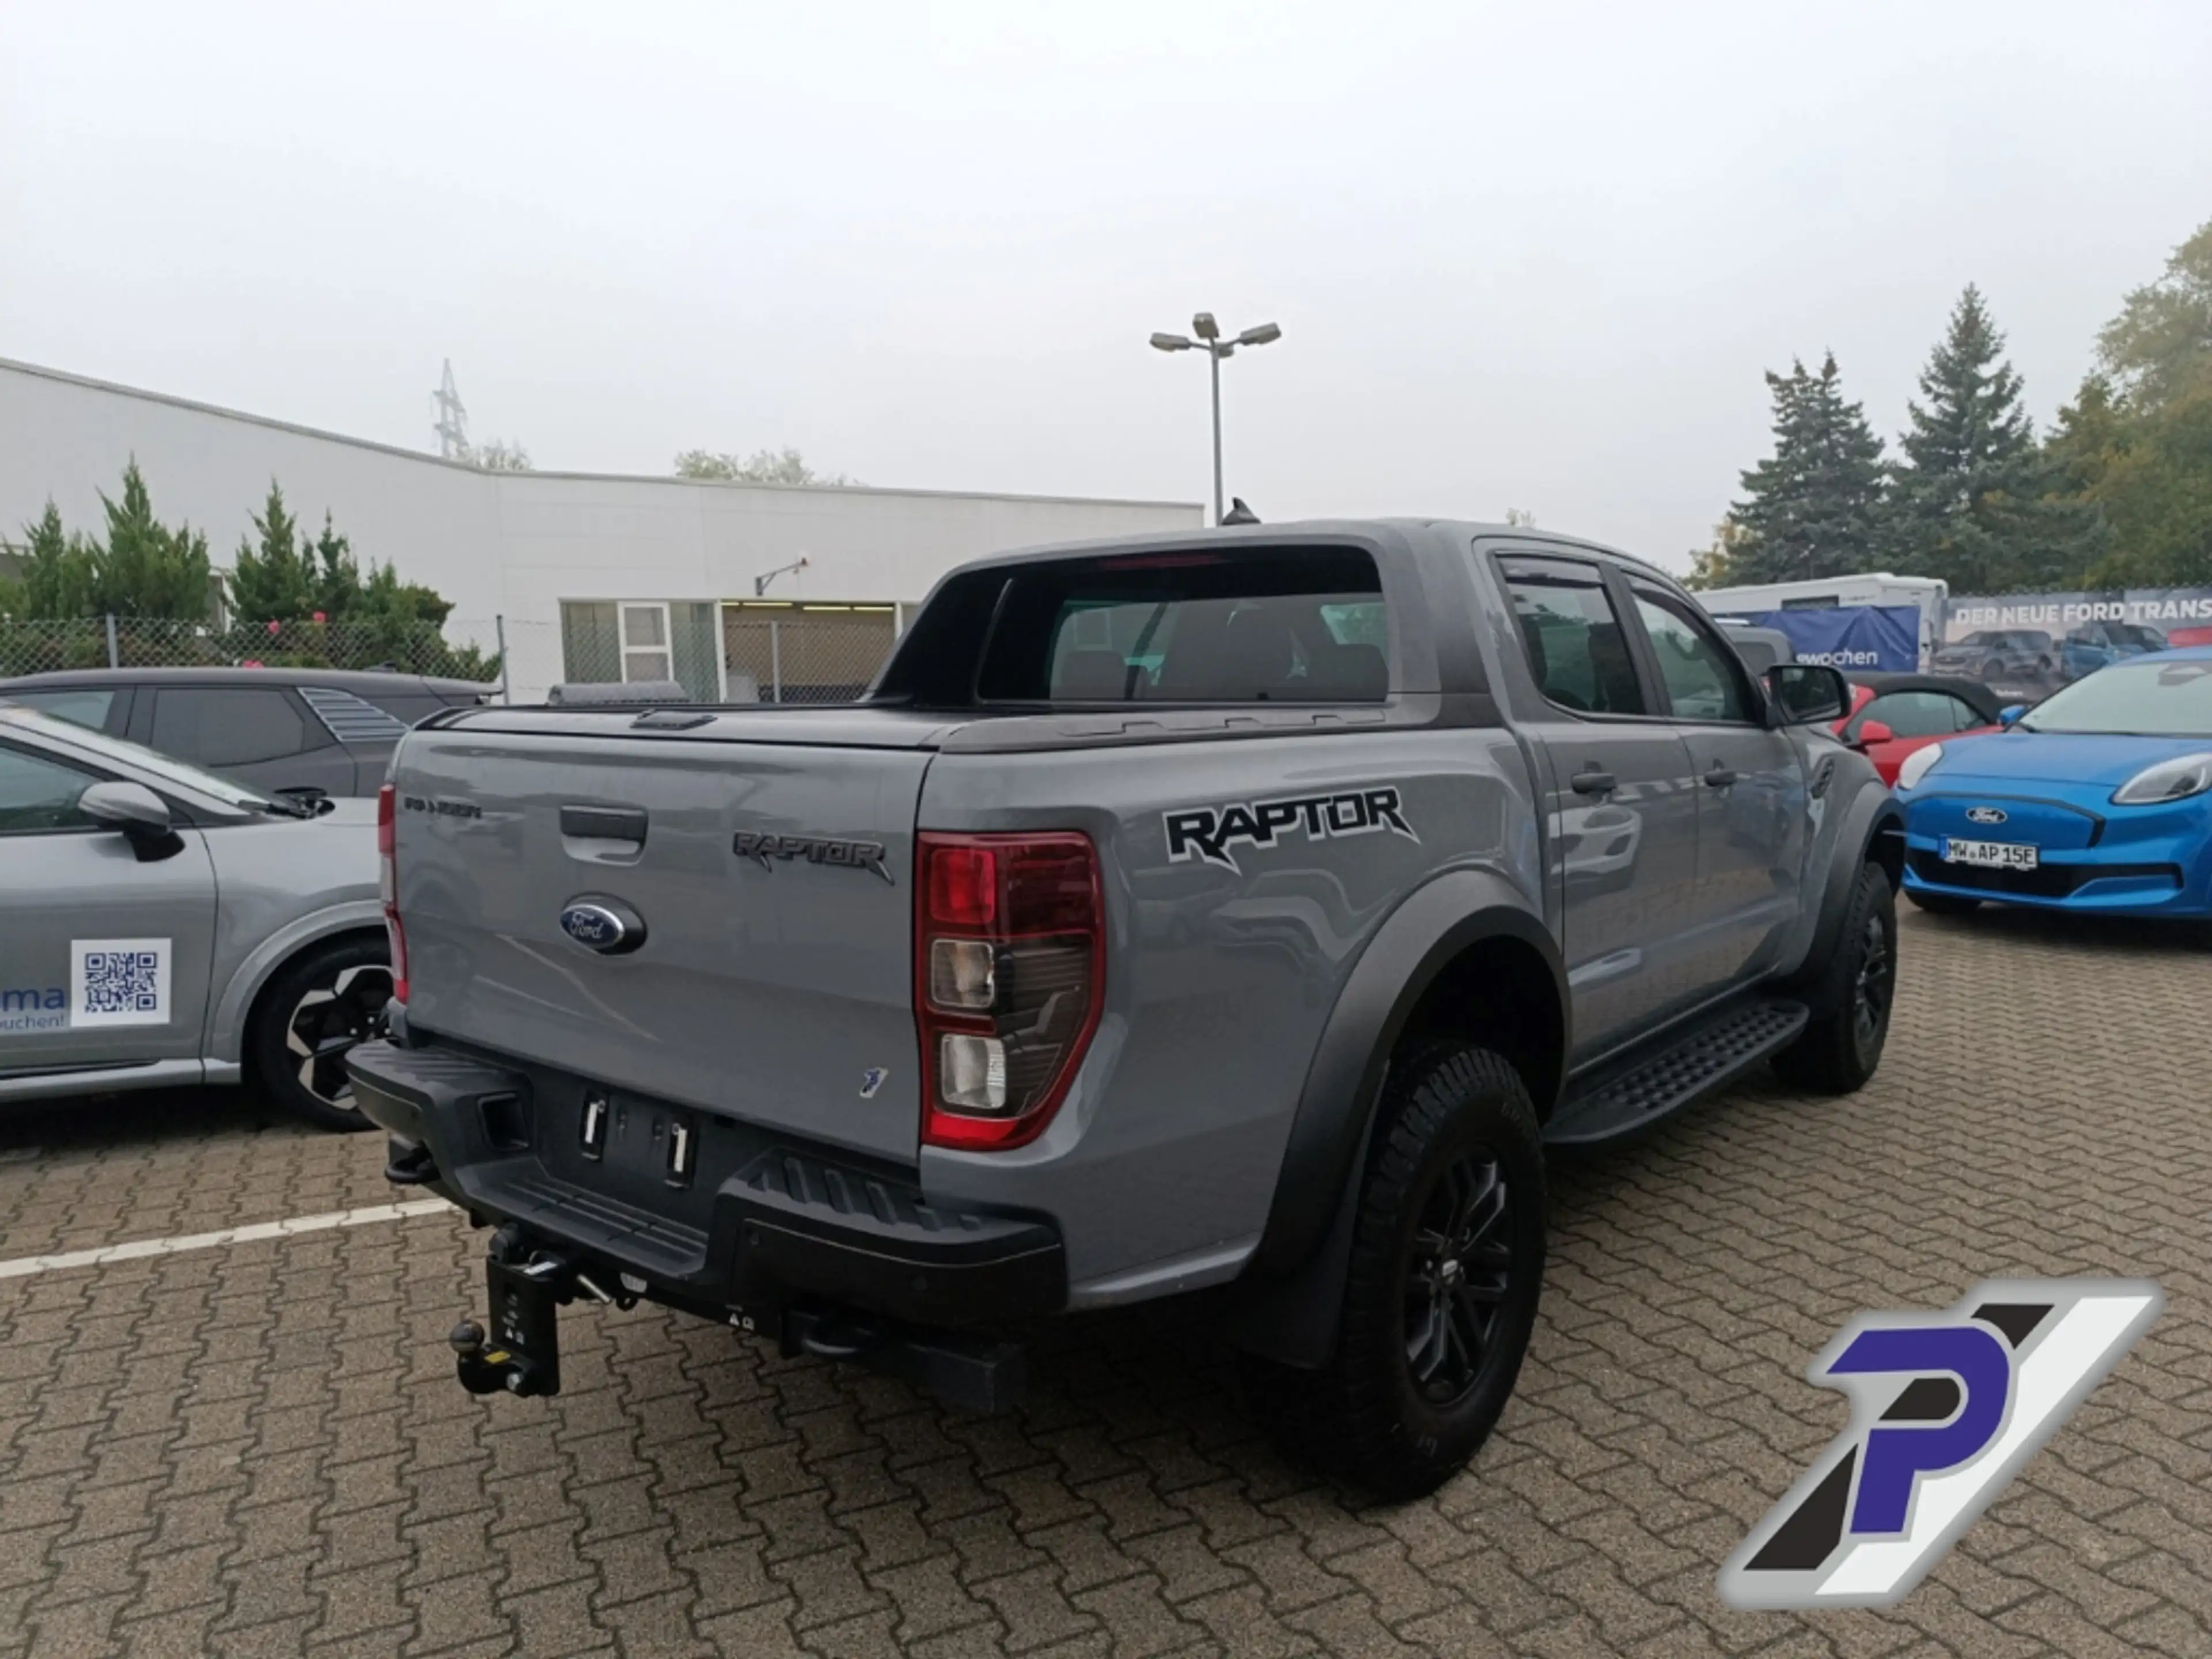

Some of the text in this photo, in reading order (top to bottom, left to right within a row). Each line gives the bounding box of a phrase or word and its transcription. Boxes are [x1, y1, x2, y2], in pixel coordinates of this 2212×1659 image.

[1955, 607, 1997, 626] DER
[2002, 604, 2060, 624] NEUE
[2063, 601, 2125, 622] FORD
[1162, 785, 1422, 877] RAPTOR
[733, 830, 896, 886] RAPTOR
[1948, 842, 2033, 864] MW AP 15E
[570, 911, 604, 939] Ford
